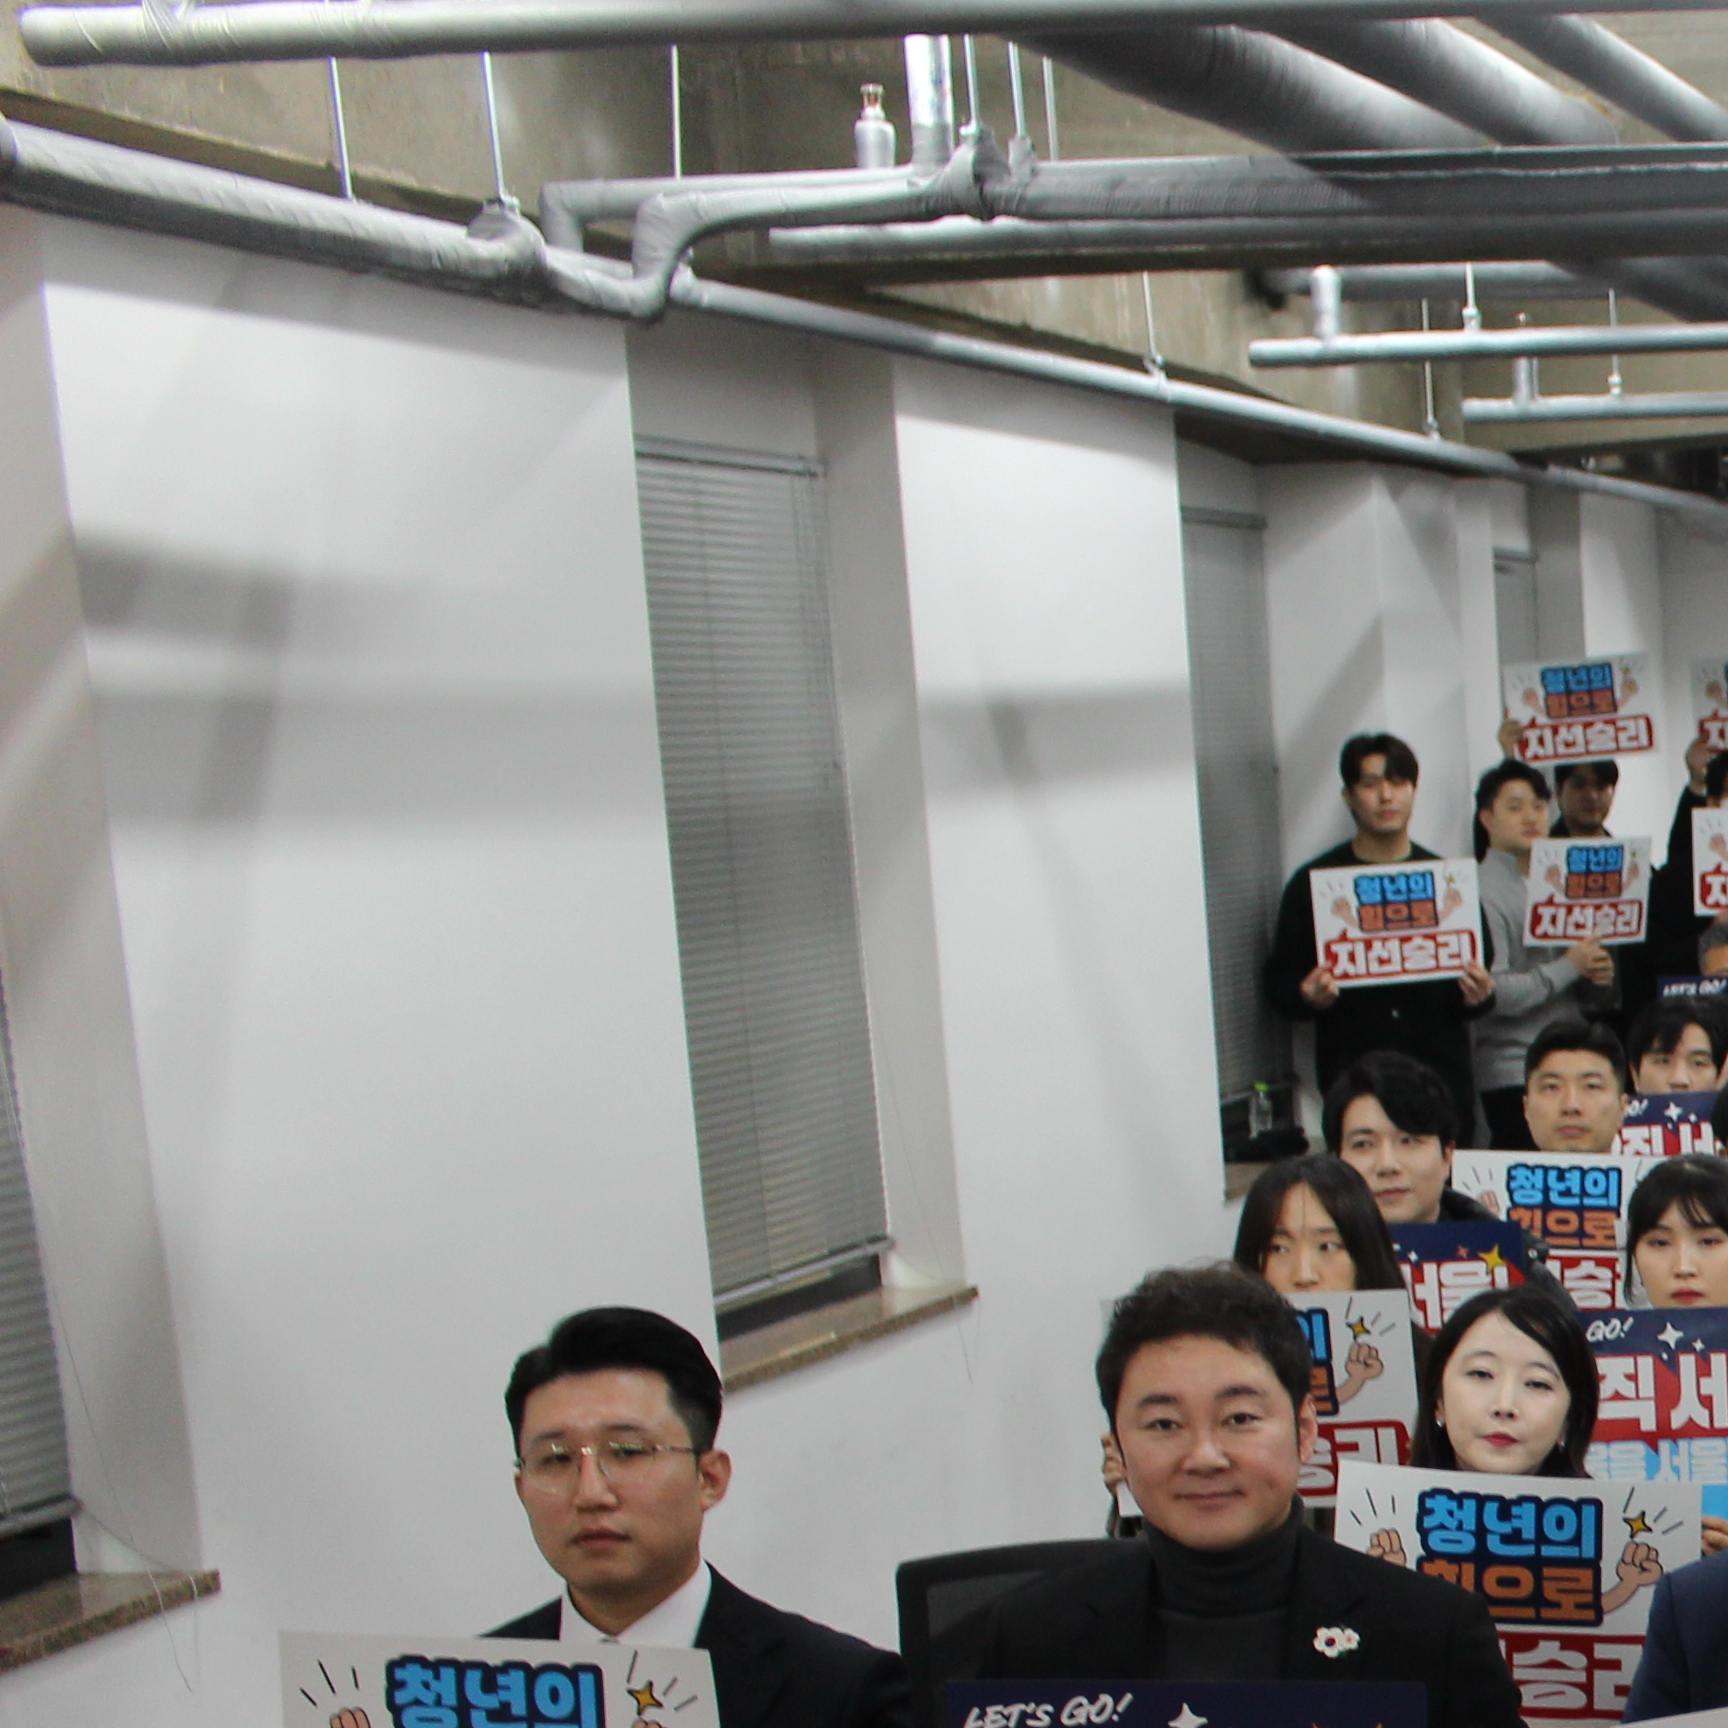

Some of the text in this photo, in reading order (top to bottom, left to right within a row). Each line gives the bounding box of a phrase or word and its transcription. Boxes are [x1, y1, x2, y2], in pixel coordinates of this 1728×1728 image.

[1523, 716, 1650, 760] 지선승리
[1355, 869, 1437, 905] 청년의
[1537, 901, 1640, 939] 지선승리
[1331, 933, 1472, 976] 지선승리
[1508, 1165, 1619, 1208] 청년의
[1586, 1316, 1635, 1342] GO!
[1422, 1493, 1597, 1560] 청년의
[1059, 1692, 1133, 1728] GO!
